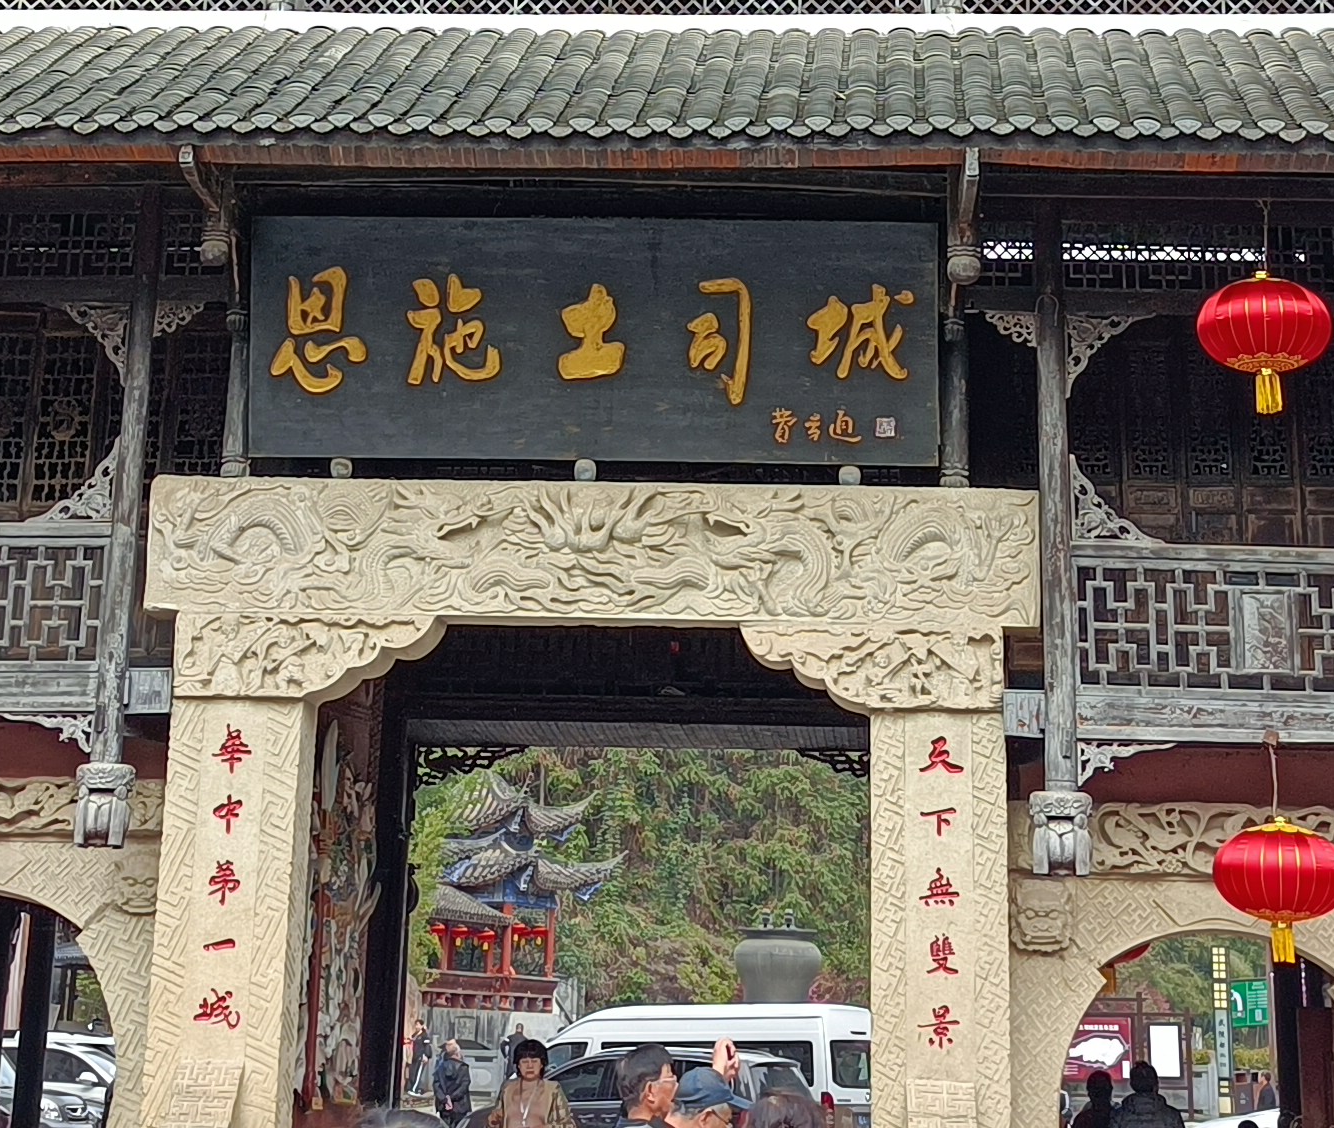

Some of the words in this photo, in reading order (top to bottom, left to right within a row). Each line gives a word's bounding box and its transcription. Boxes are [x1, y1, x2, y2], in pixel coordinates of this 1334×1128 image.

[270, 266, 915, 405] 恩施土司城
